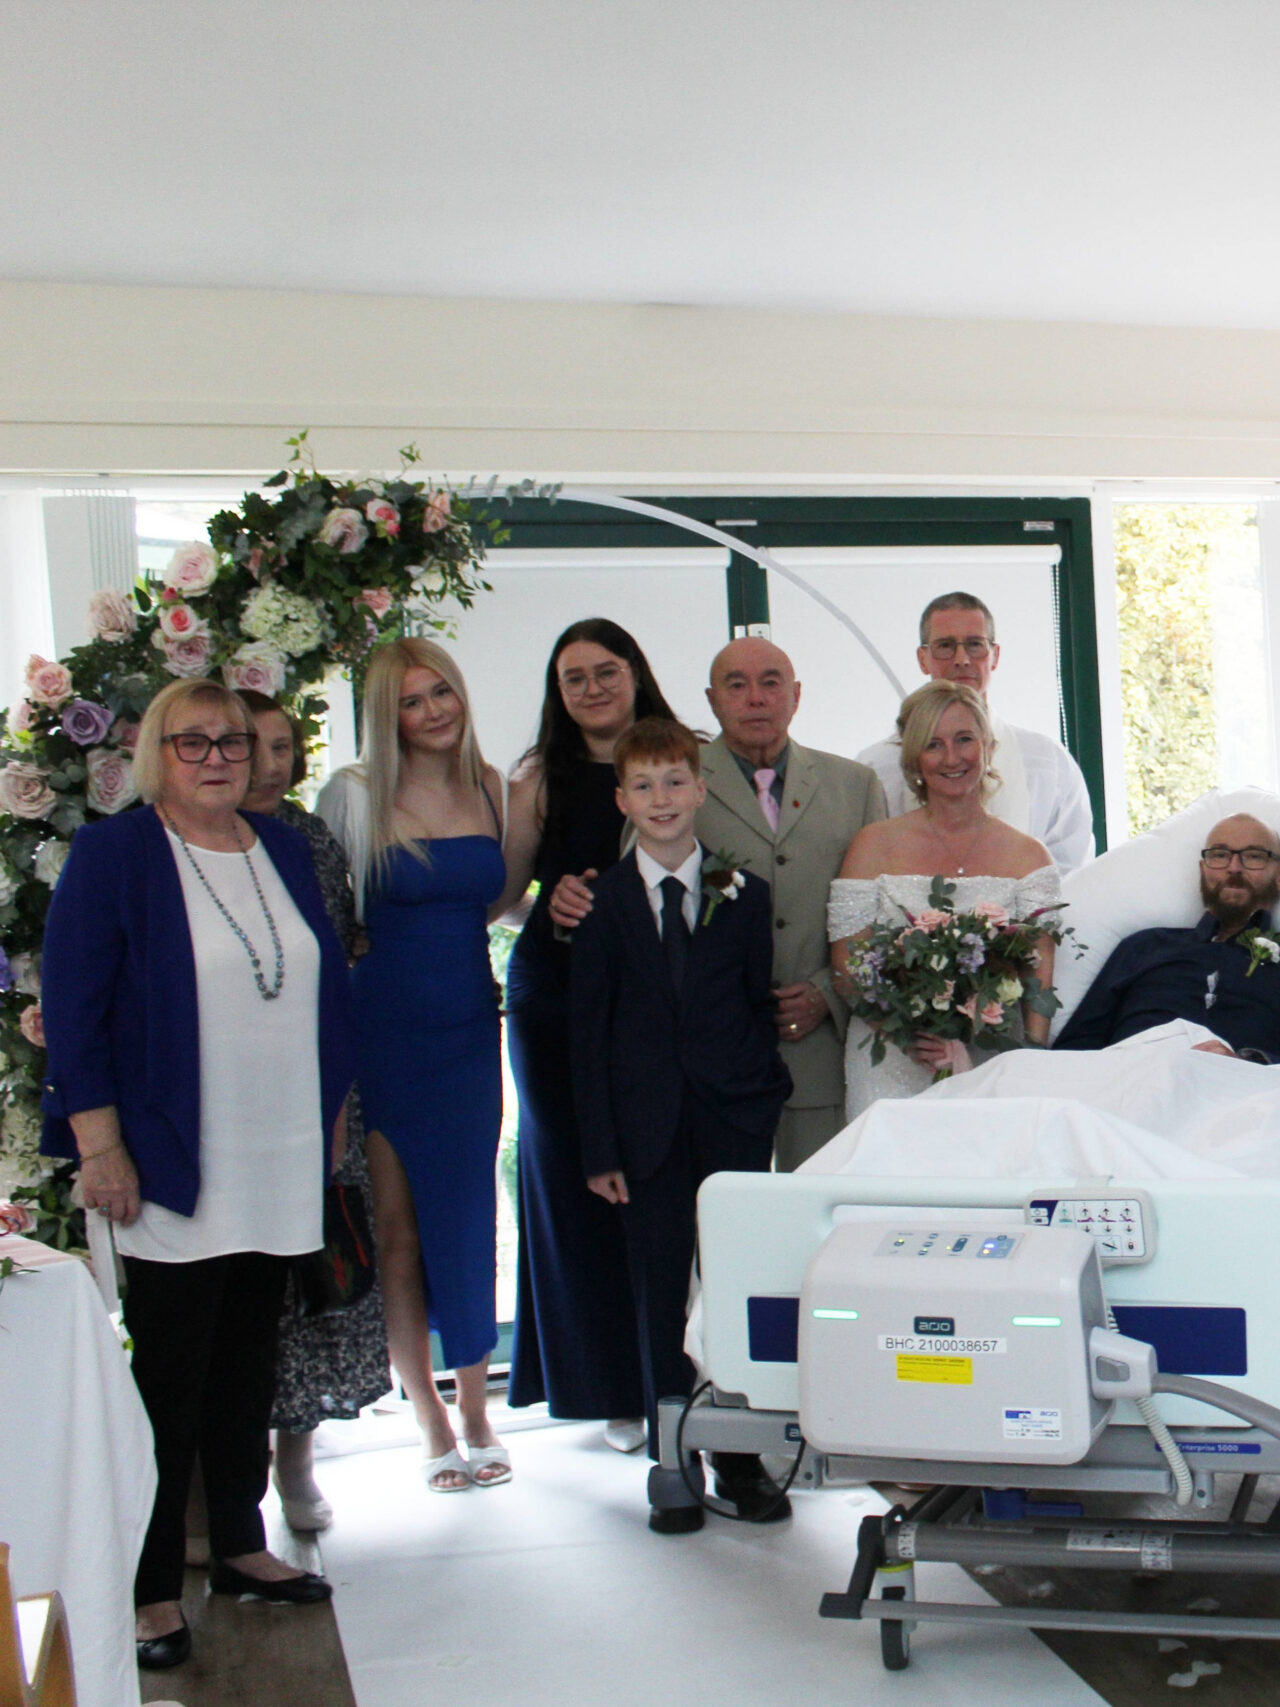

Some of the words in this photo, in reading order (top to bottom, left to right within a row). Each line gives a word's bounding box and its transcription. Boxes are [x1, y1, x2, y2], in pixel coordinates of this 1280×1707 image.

[885, 1337, 914, 1350] BHC
[919, 1339, 998, 1352] 2100038657
[1178, 1443, 1215, 1452] nterprise
